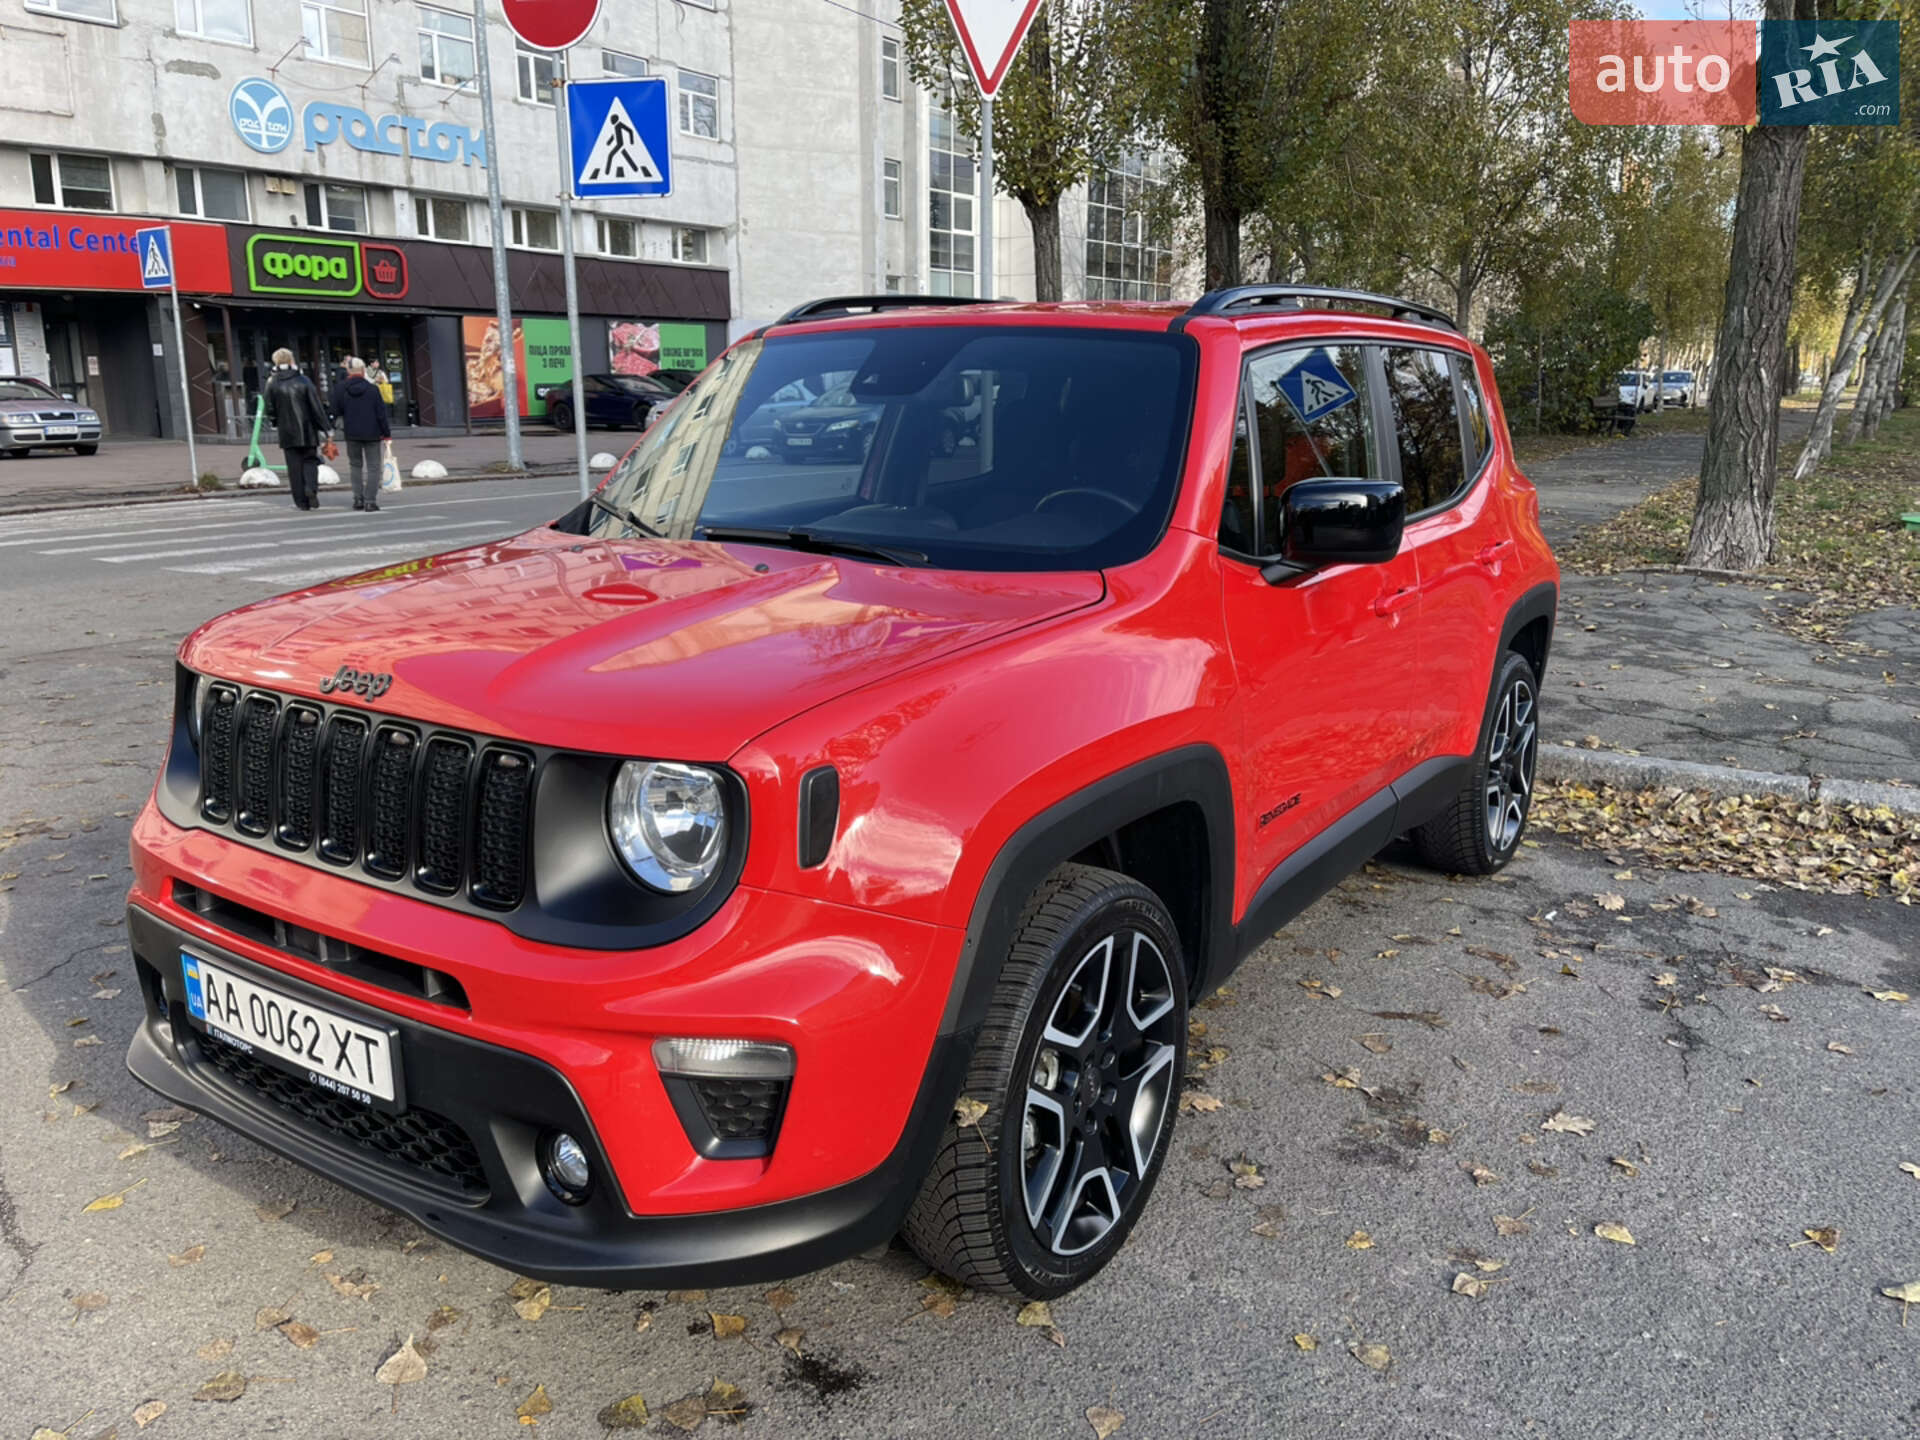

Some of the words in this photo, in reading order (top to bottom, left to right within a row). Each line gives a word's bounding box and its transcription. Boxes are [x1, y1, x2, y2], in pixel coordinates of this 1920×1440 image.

[68, 226, 138, 255] Cente
[549, 344, 571, 356] ПРЯМ
[320, 665, 393, 702] Jeep
[191, 993, 203, 1008] UA
[206, 973, 245, 1031] AA
[249, 992, 325, 1066] 0062
[329, 1022, 380, 1085] XT
